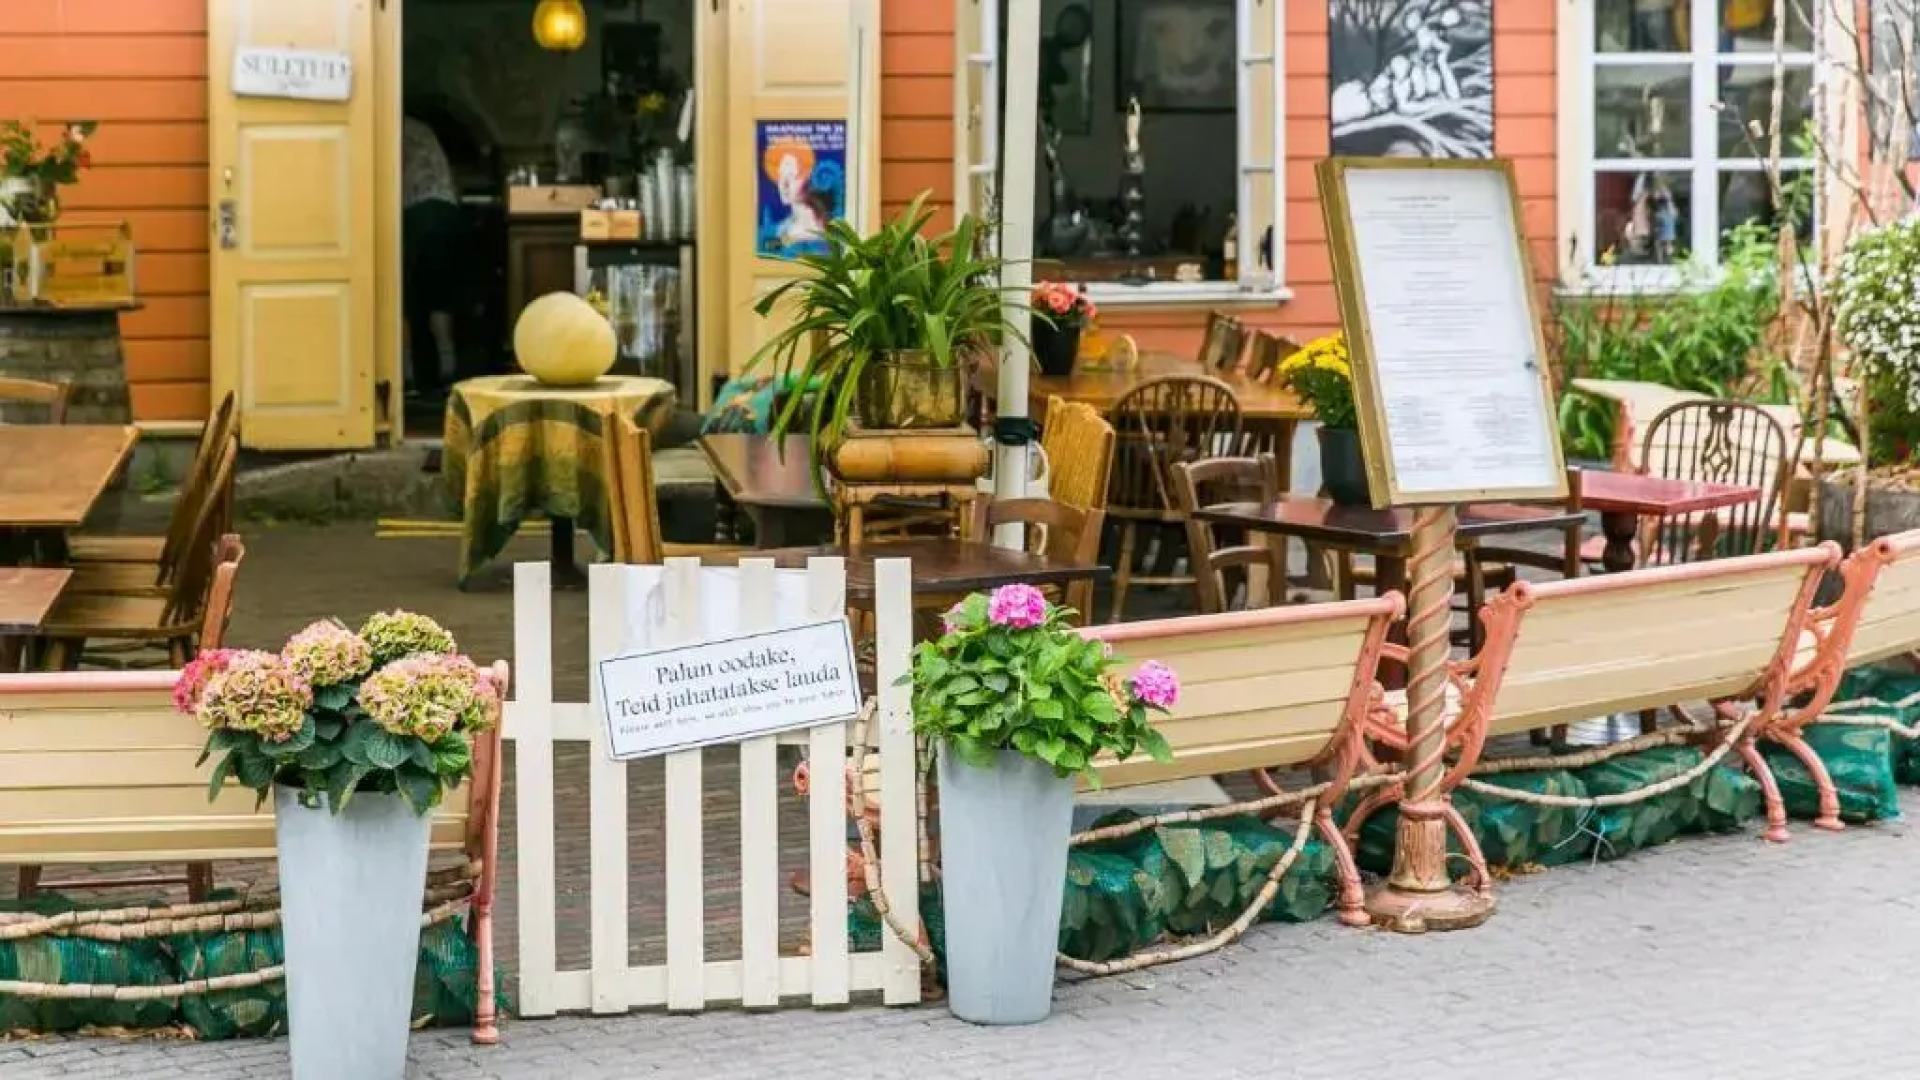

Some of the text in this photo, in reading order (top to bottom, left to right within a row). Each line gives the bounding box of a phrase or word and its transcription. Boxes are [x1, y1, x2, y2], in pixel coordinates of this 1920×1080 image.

[656, 647, 796, 685] Palun oodake,
[615, 663, 840, 717] Teid juhatatakse lauda
